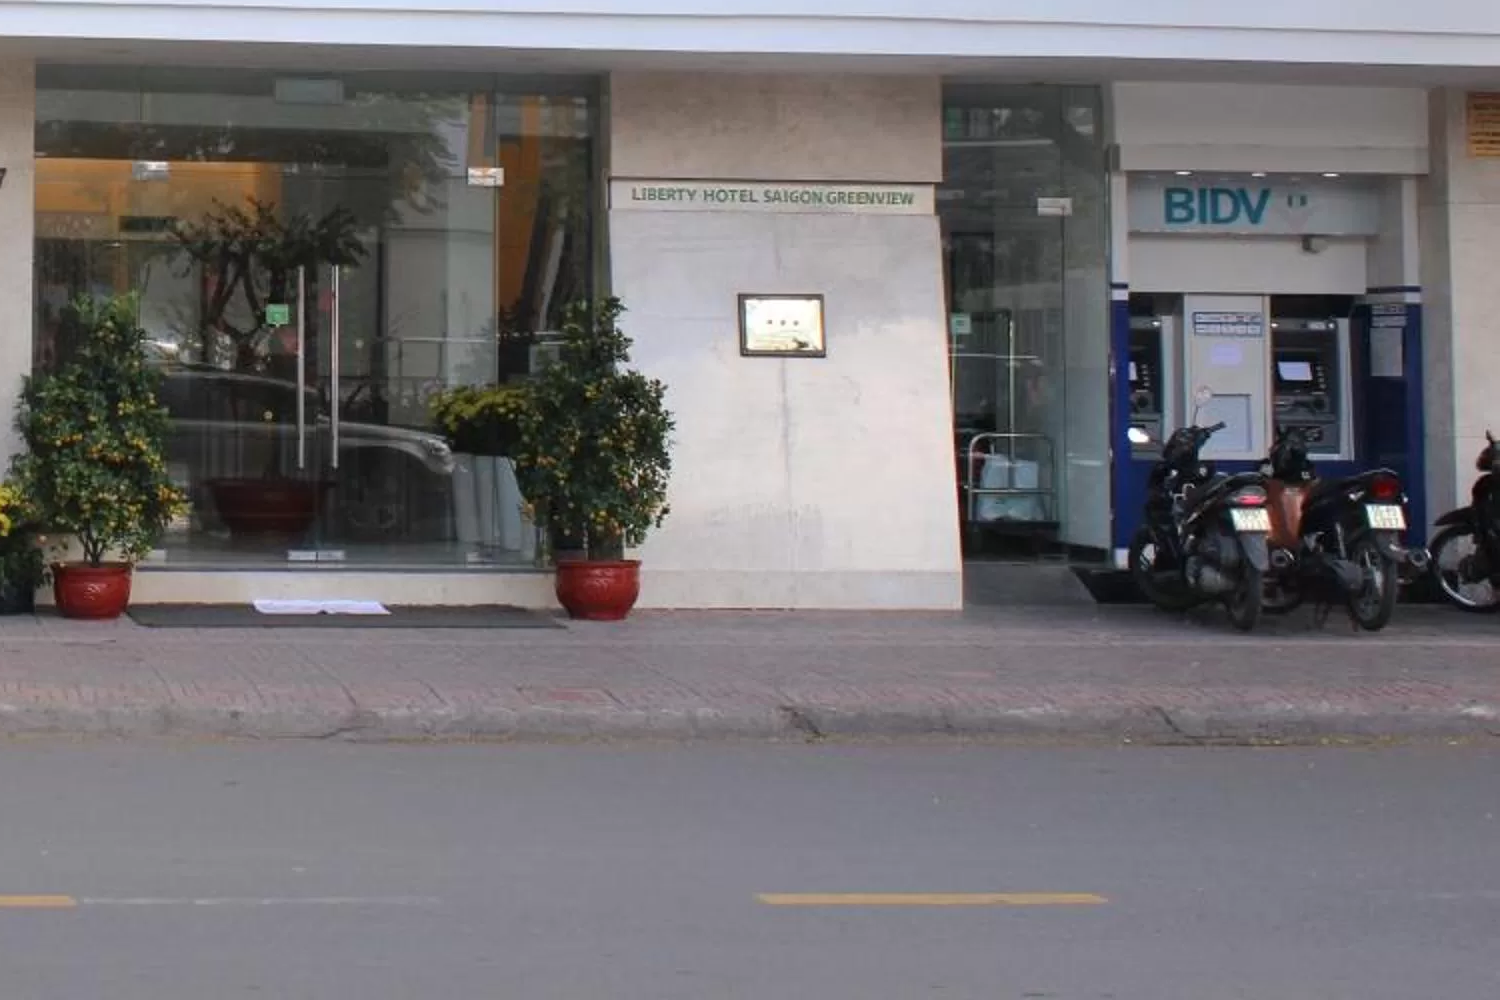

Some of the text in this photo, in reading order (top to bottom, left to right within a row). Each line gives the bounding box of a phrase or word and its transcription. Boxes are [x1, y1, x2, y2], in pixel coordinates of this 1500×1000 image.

[631, 187, 916, 205] LIBERTY HOTEL SAIGON GREENVIEW
[1164, 187, 1271, 225] BIDV
